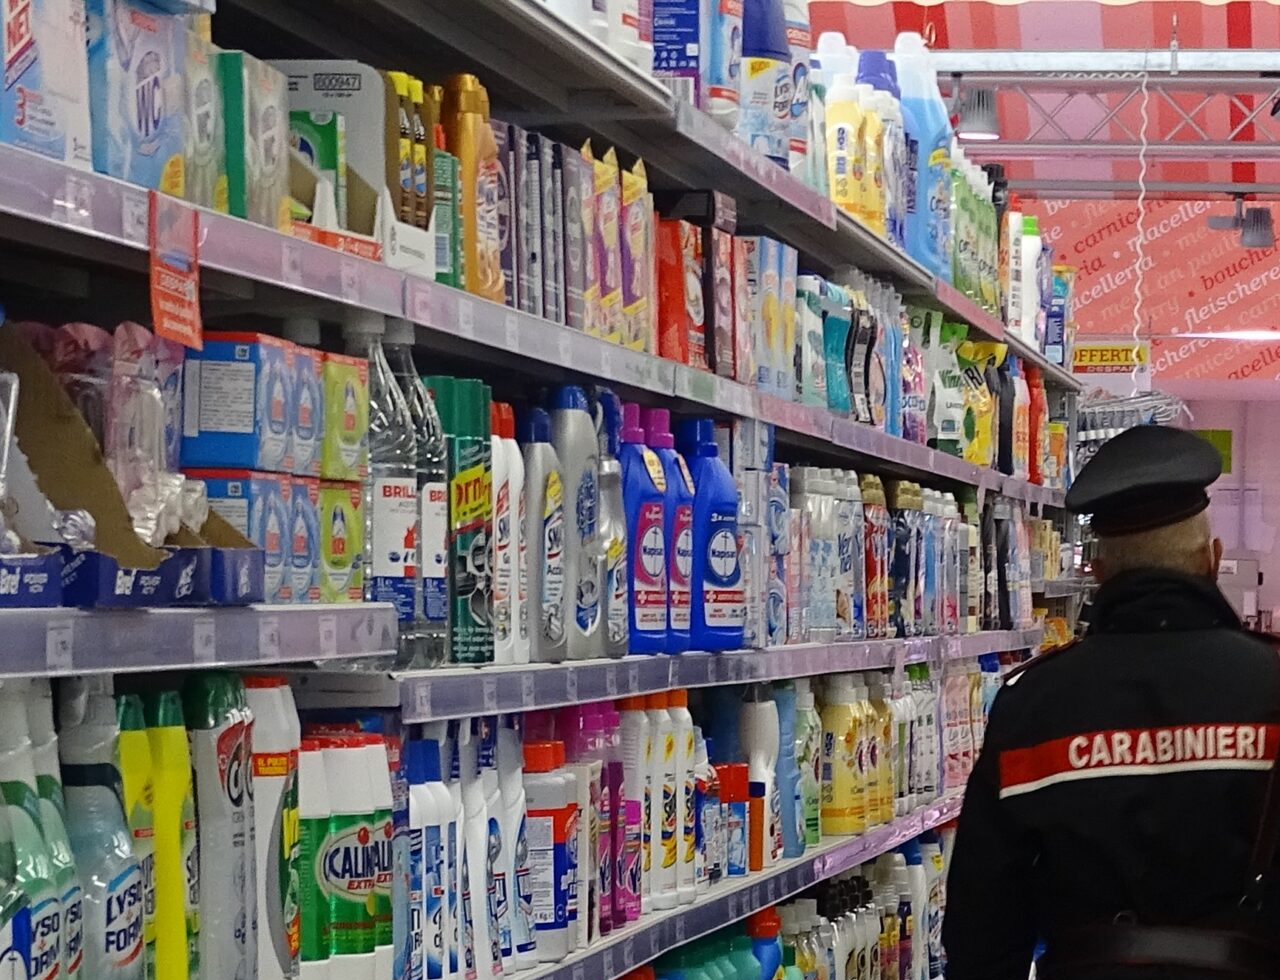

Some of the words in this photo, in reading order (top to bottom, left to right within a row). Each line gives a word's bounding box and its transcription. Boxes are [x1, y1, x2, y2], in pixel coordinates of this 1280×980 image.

[1068, 725, 1268, 769] CARABINIERI
[328, 846, 375, 879] CALIN
[32, 911, 60, 945] YSO
